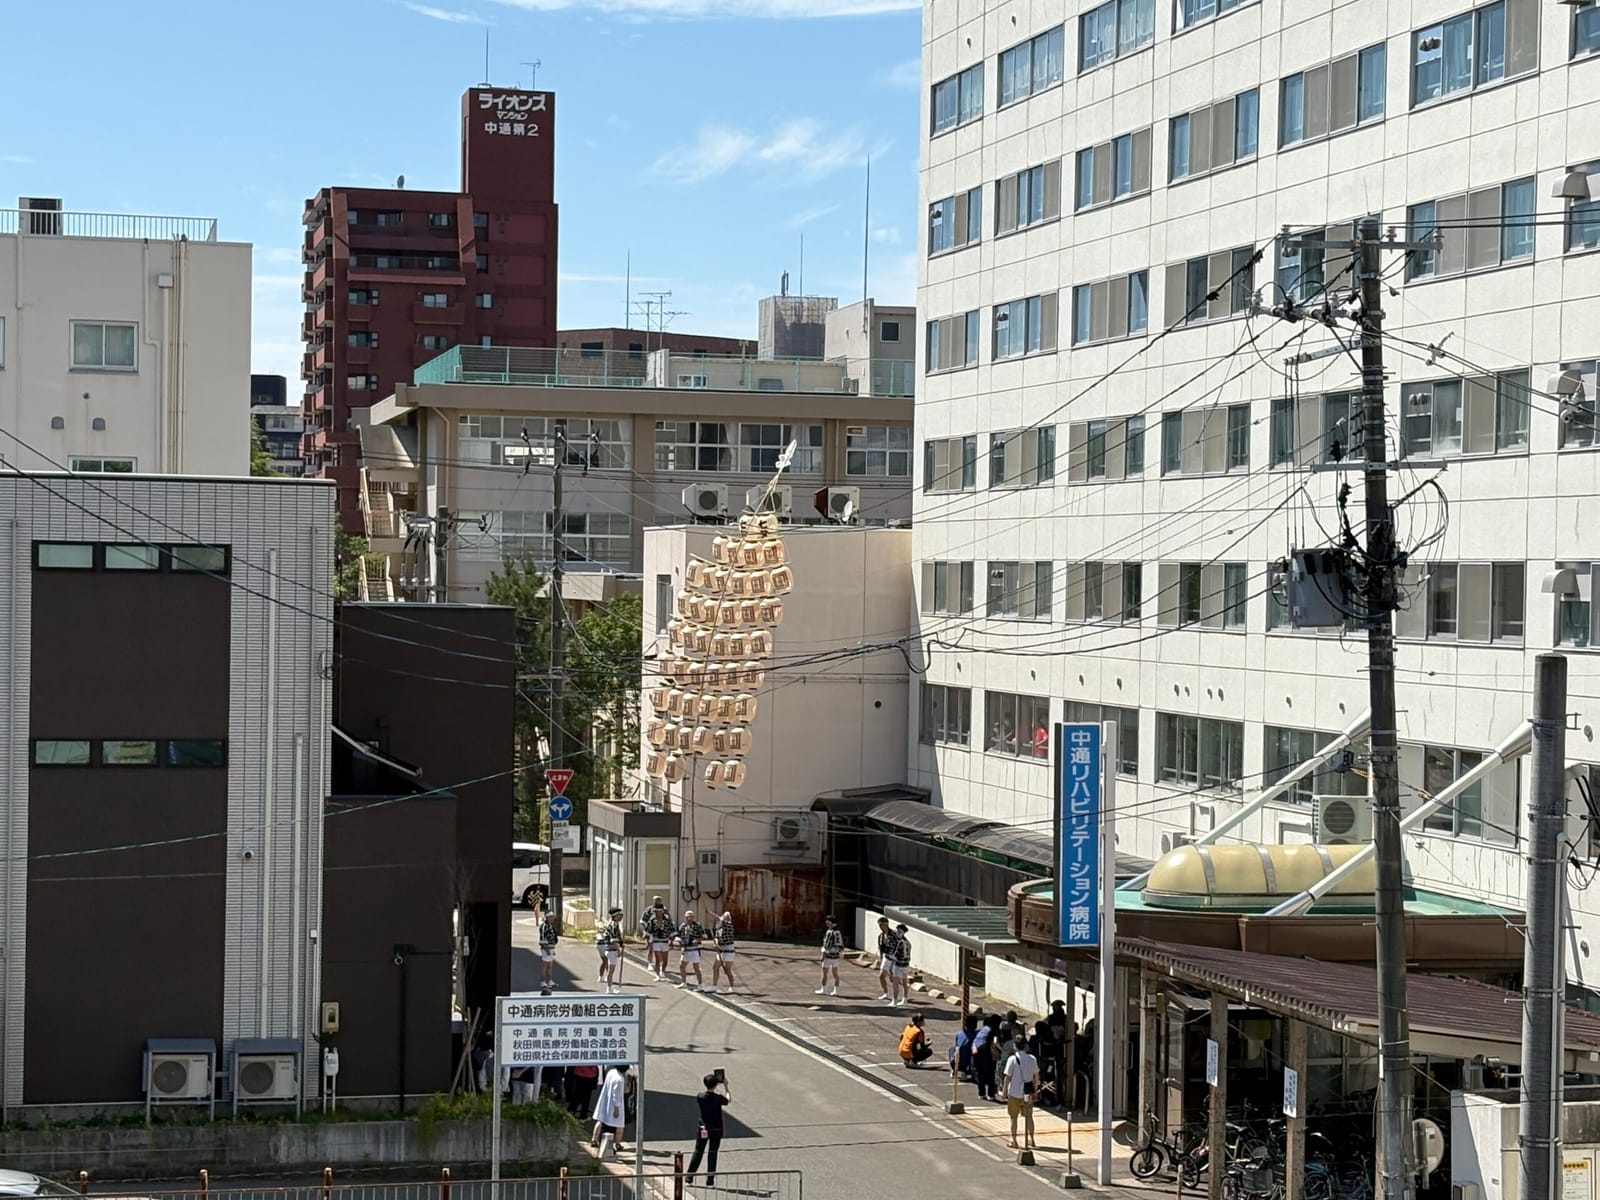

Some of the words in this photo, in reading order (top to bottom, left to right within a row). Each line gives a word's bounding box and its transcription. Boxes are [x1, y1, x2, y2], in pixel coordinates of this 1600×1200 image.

[478, 93, 546, 111] ライオンズ
[496, 110, 528, 120] マンション
[1069, 730, 1091, 940] 中通リハビリテーション病院
[507, 1003, 634, 1018] 中通病院労働組合会館
[513, 1026, 628, 1038] 中通病院労働組合
[513, 1038, 627, 1050] 秋田県医療労働組合連合会
[513, 1049, 627, 1062] 秋田県社会保障推進協議会
